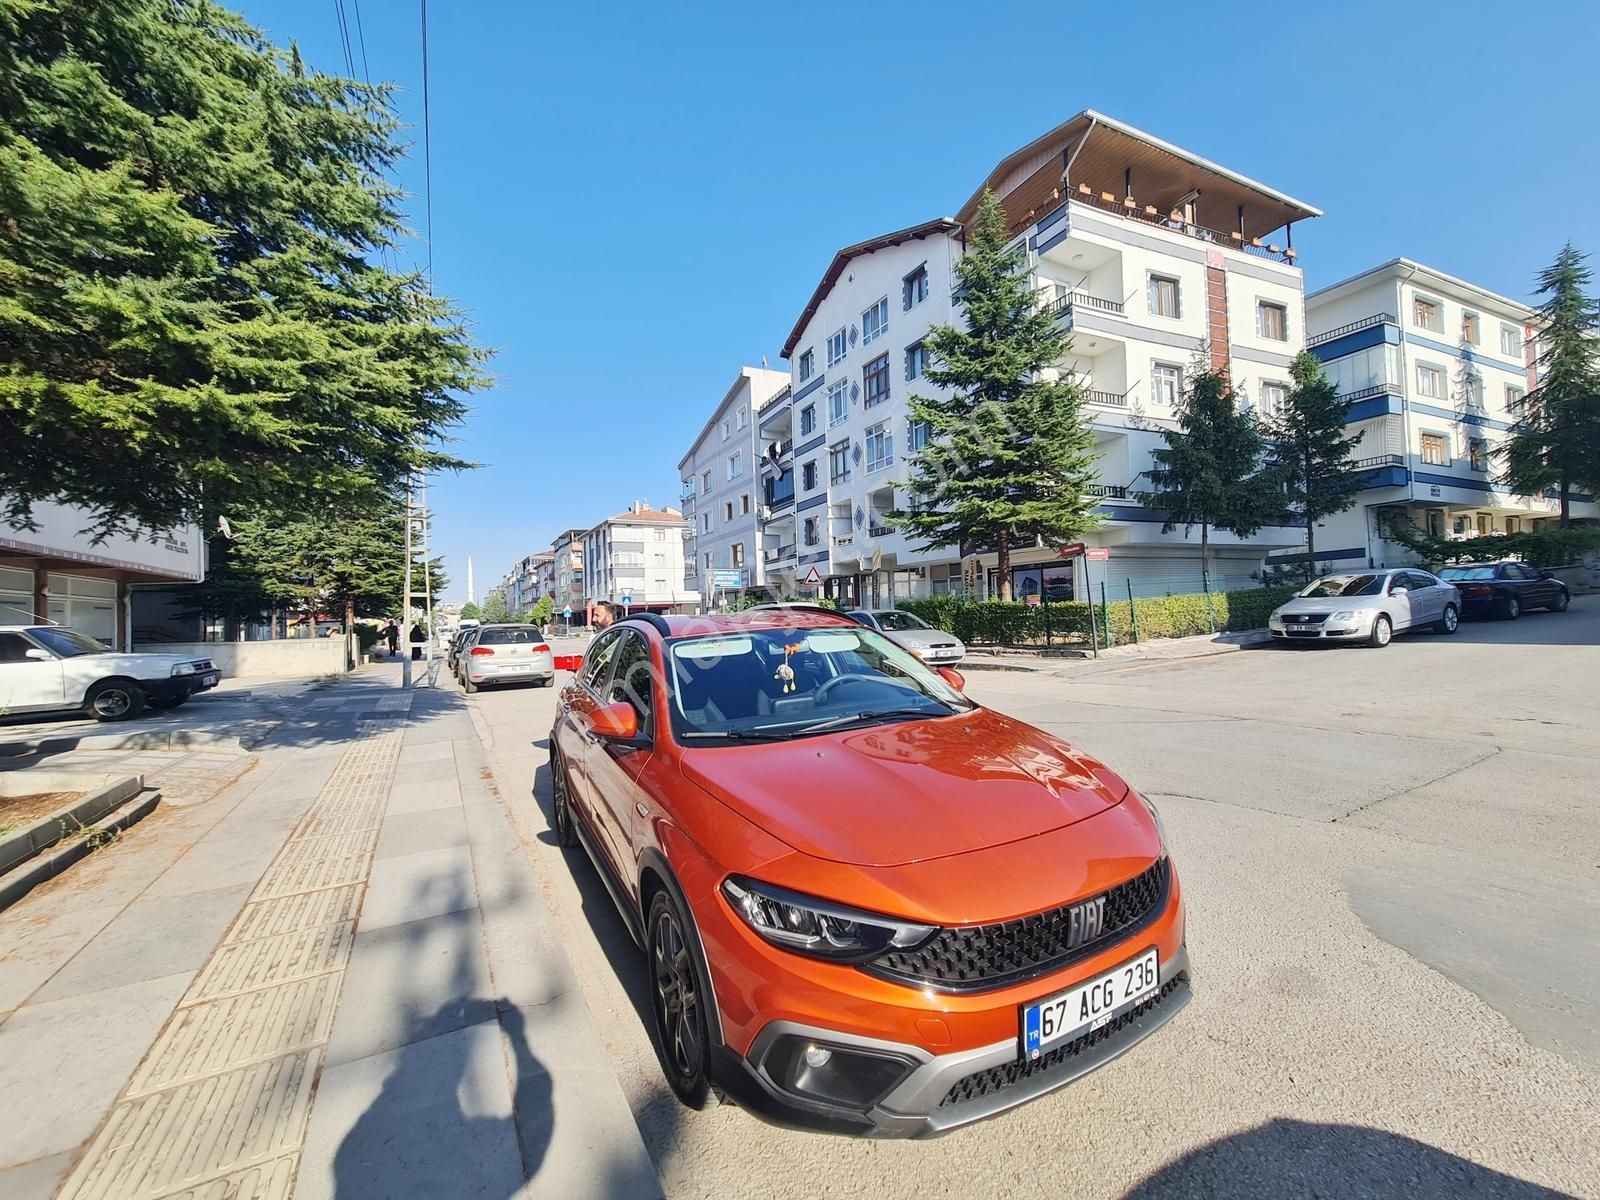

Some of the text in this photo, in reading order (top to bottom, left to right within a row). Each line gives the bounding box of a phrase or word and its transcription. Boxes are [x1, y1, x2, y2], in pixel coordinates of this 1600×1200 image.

[1068, 896, 1106, 948] FIAT
[1029, 1030, 1039, 1042] TR
[1043, 999, 1067, 1037] 67
[1080, 978, 1113, 1021] ACG
[1124, 957, 1153, 998] 236
